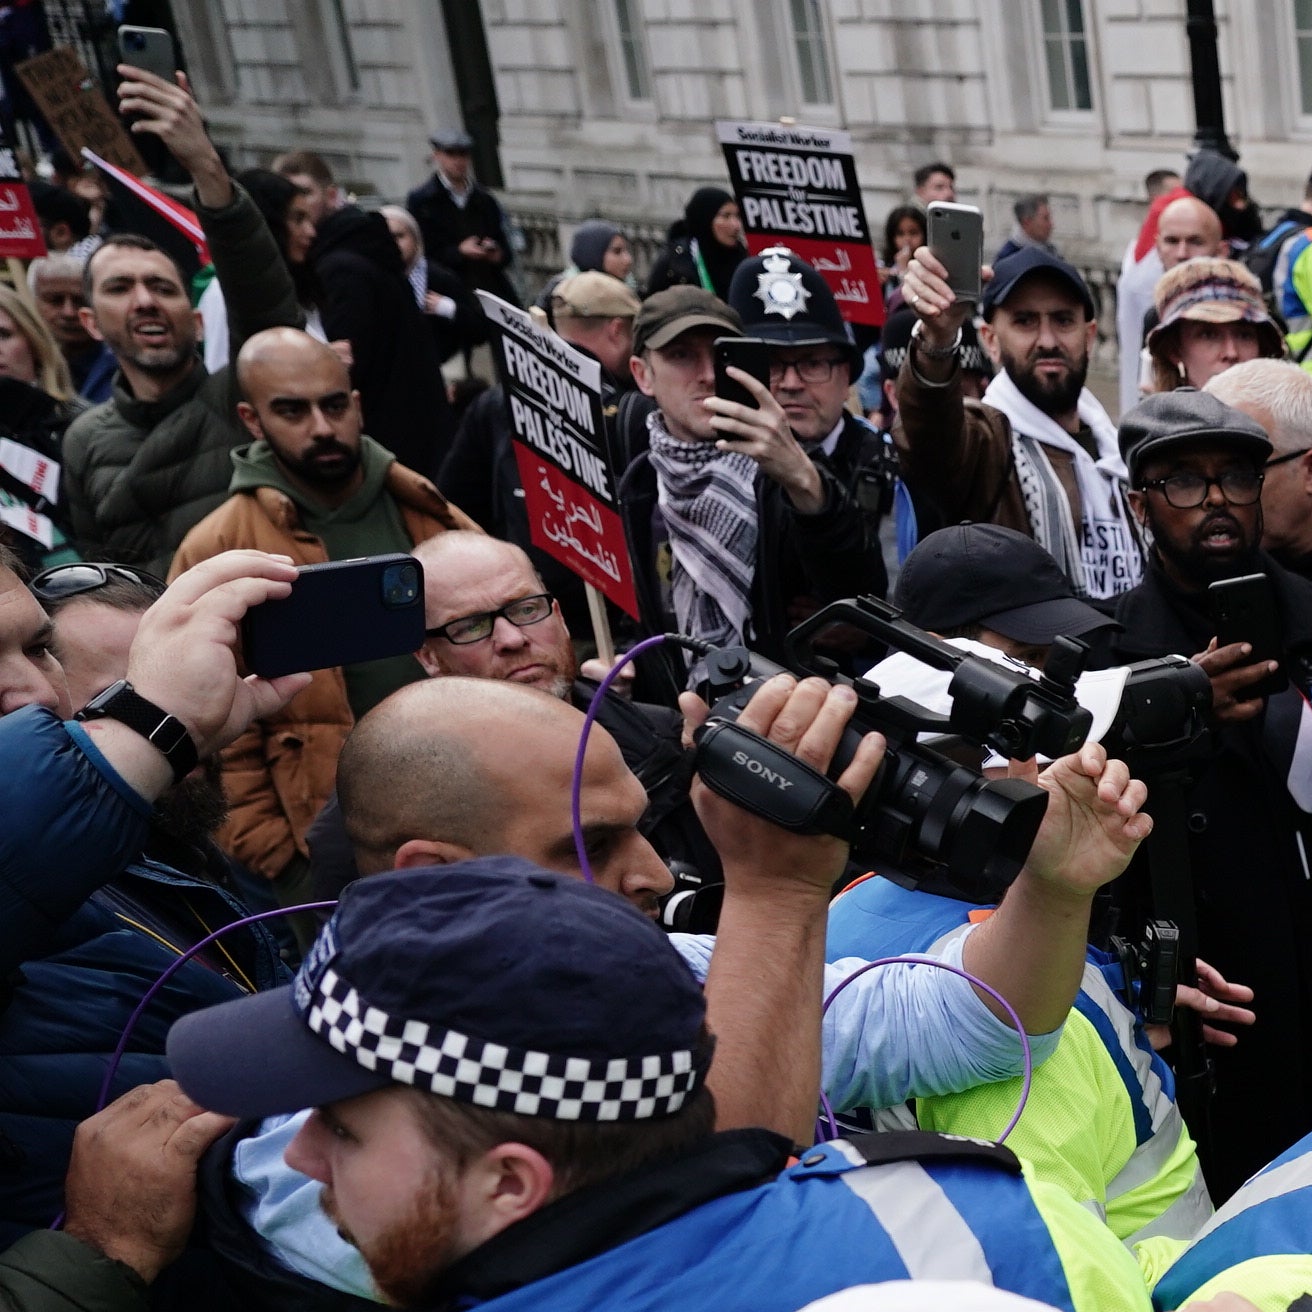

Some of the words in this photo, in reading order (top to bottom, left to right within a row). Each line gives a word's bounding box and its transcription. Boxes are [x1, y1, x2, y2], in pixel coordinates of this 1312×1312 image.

[735, 149, 848, 191] FREEDOM
[743, 196, 865, 238] PALESTINE
[501, 333, 596, 436] FREEDOM
[510, 394, 613, 502] PALESTINE
[732, 750, 794, 791] SONY
